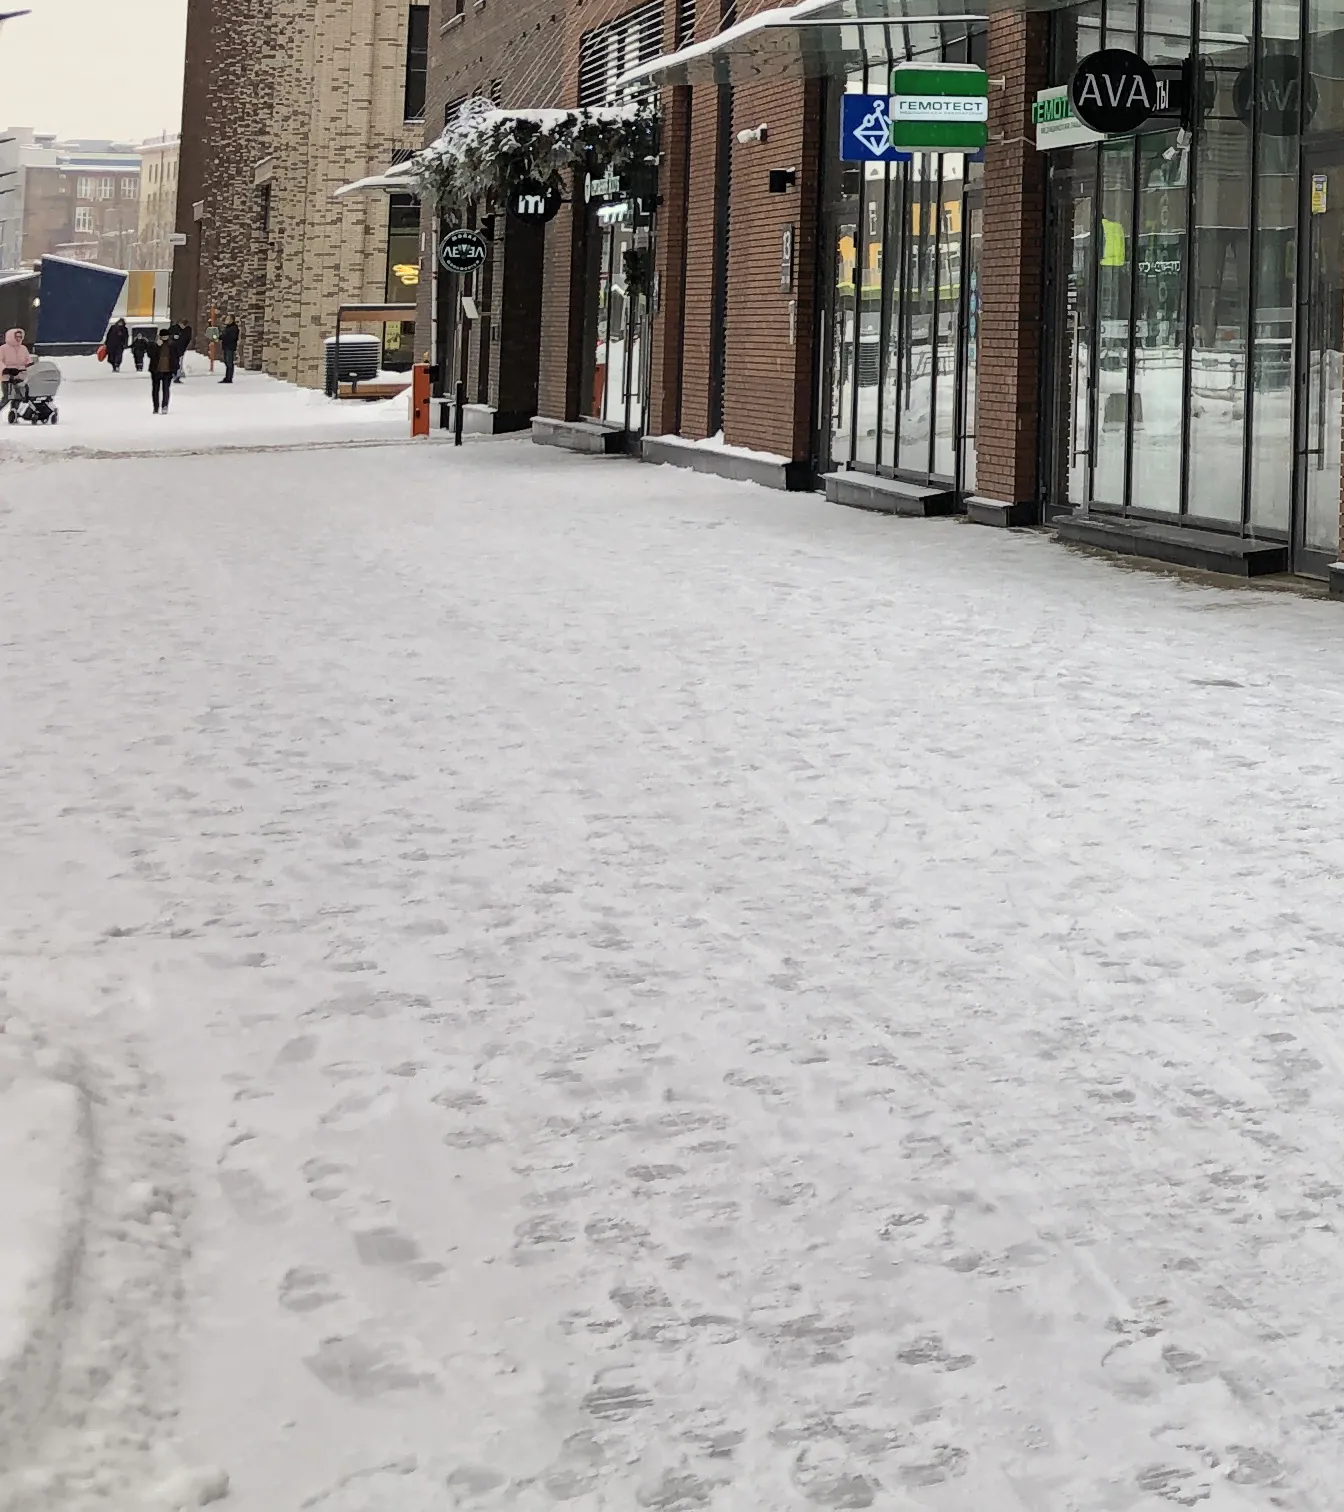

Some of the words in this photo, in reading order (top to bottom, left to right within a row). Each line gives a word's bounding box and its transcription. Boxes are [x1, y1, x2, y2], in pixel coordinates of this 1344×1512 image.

[1078, 73, 1150, 108] AVA
[900, 101, 983, 111] ГЕМОТЕСТ
[1031, 96, 1075, 124] ГЕМОТ
